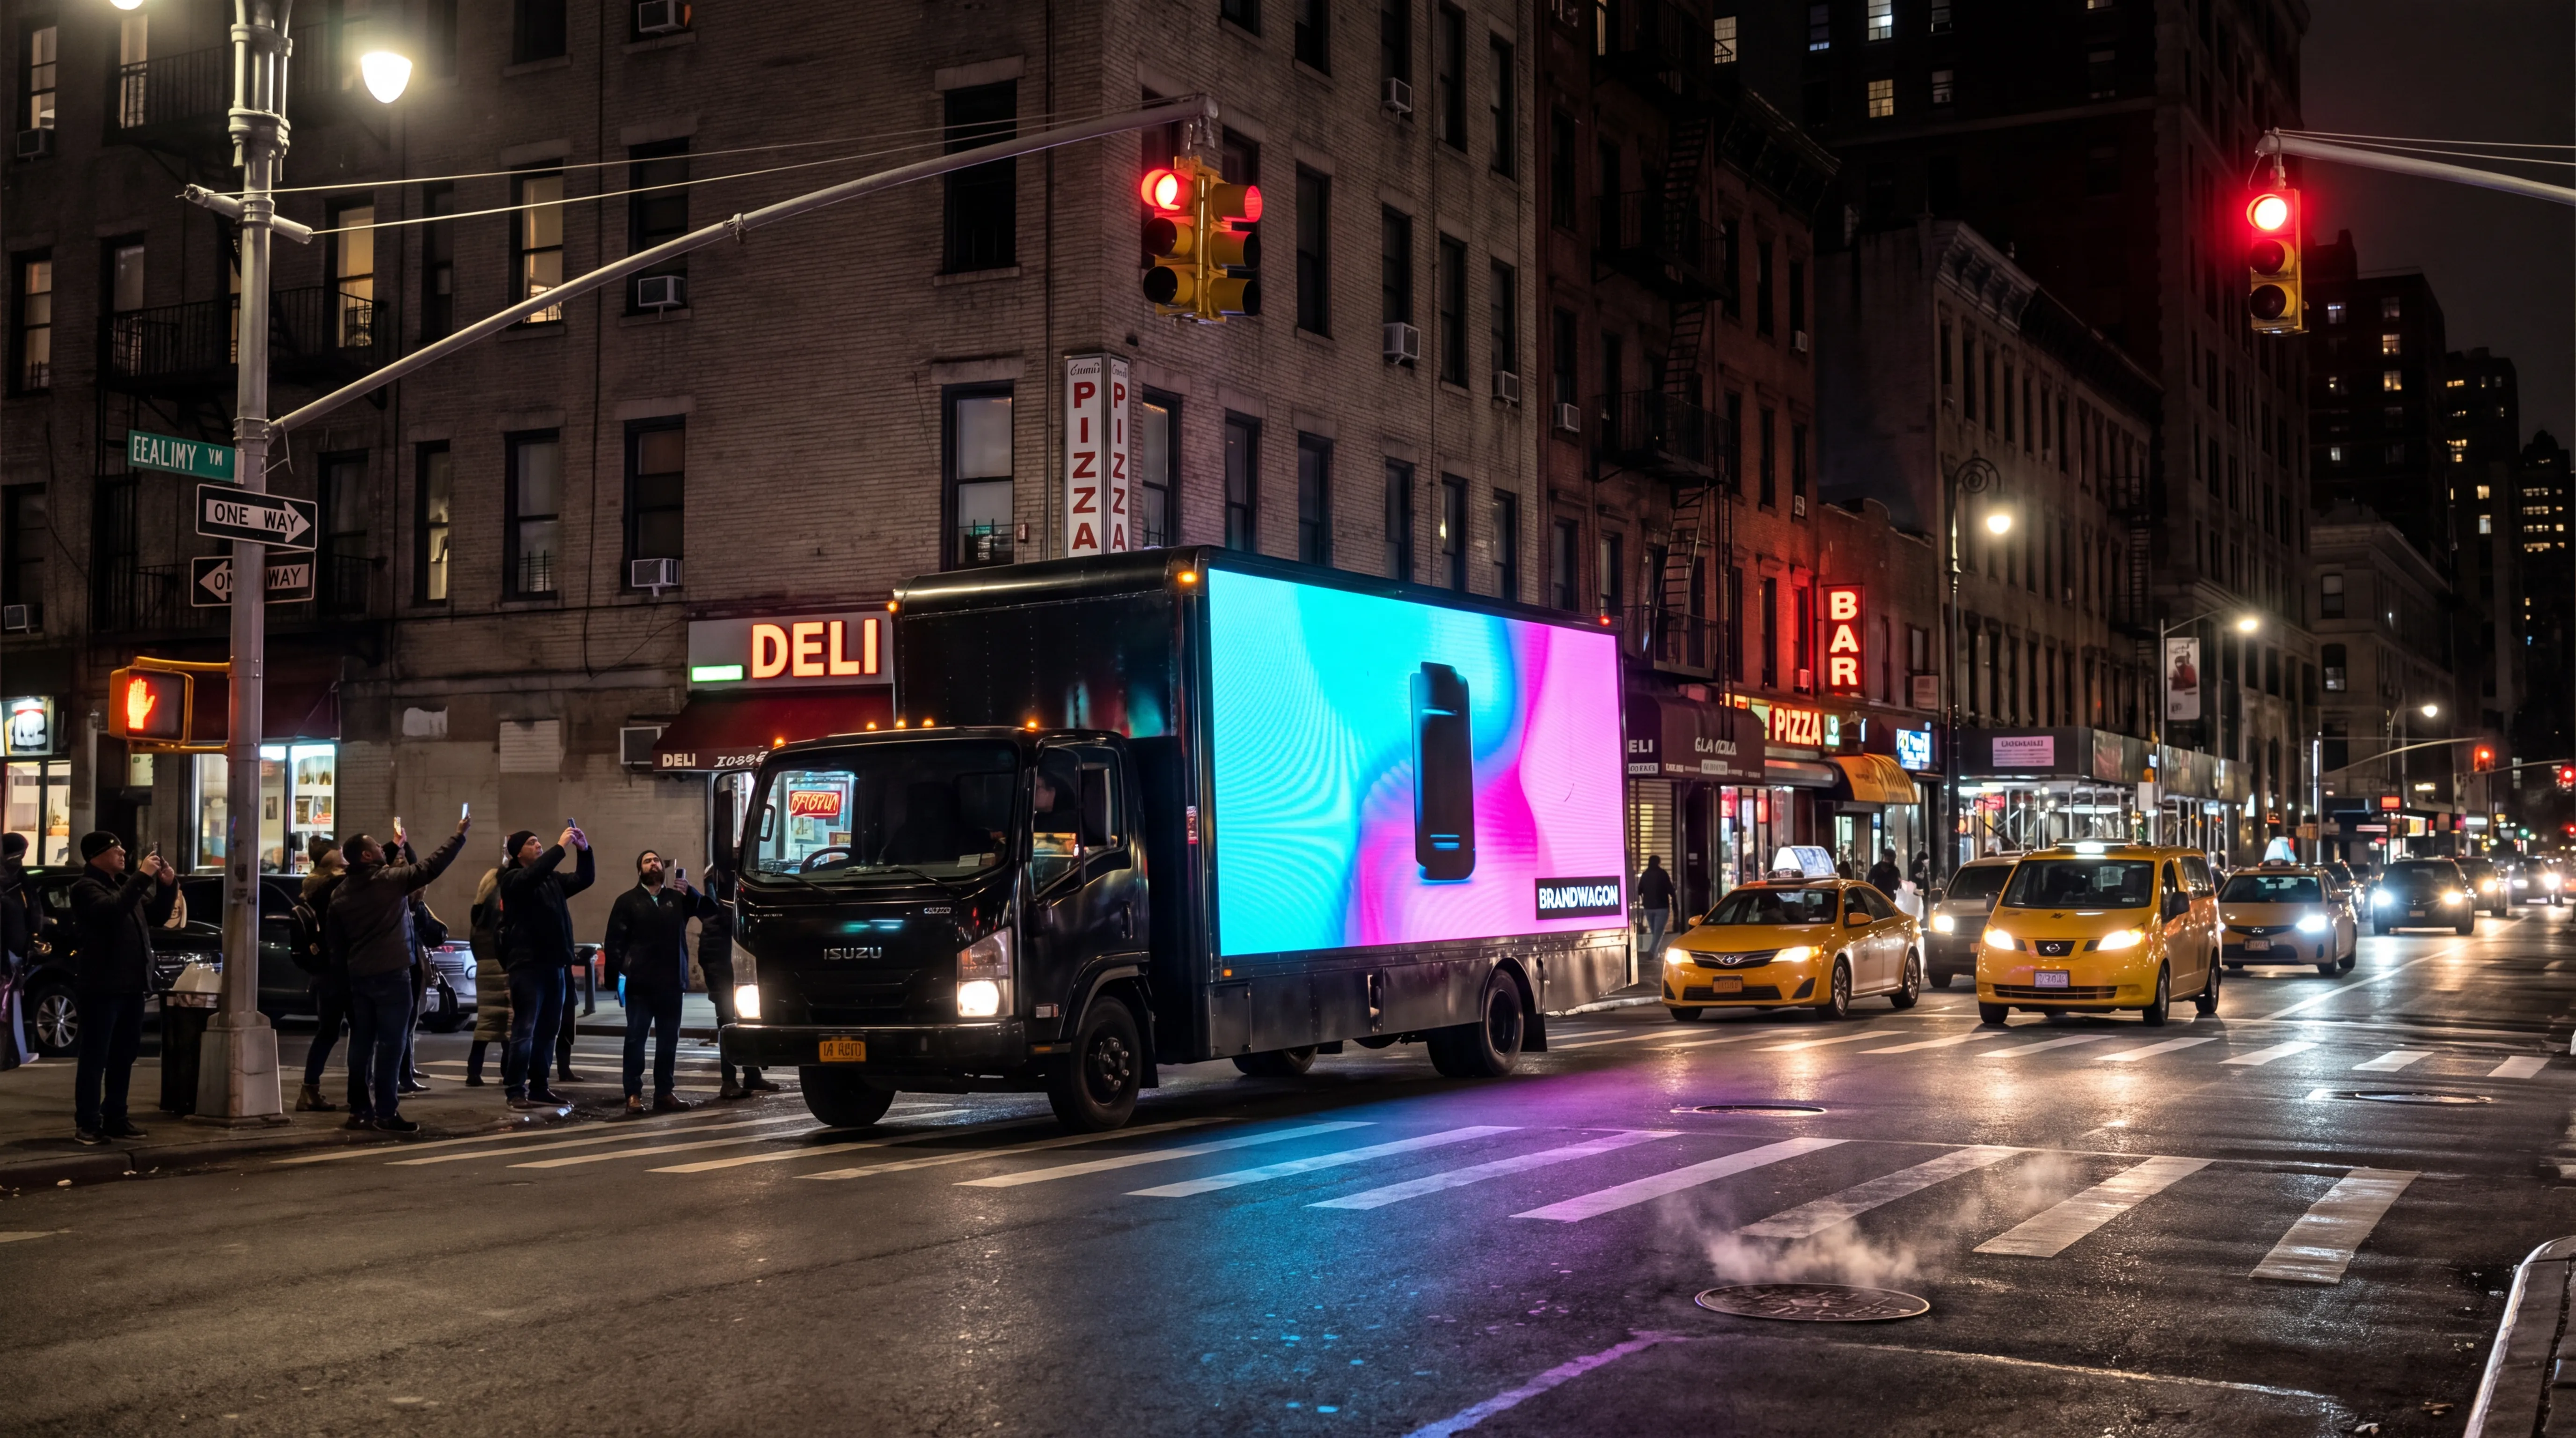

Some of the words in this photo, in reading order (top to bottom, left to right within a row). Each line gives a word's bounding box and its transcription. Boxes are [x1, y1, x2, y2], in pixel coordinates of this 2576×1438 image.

[133, 435, 197, 471] EEALIMY
[1072, 381, 1098, 550] PIZZA
[1112, 382, 1127, 551] PIZZA
[214, 503, 249, 525] ONE
[263, 510, 299, 532] WAY
[214, 572, 233, 591] ON
[268, 567, 301, 587] WAY
[752, 618, 878, 679] DELI
[1830, 591, 1859, 686] BAR
[1775, 708, 1822, 746] PIZZA
[662, 753, 696, 767] DELI
[1539, 885, 1618, 909] BRANDWAGON
[823, 946, 882, 960] ISUZU
